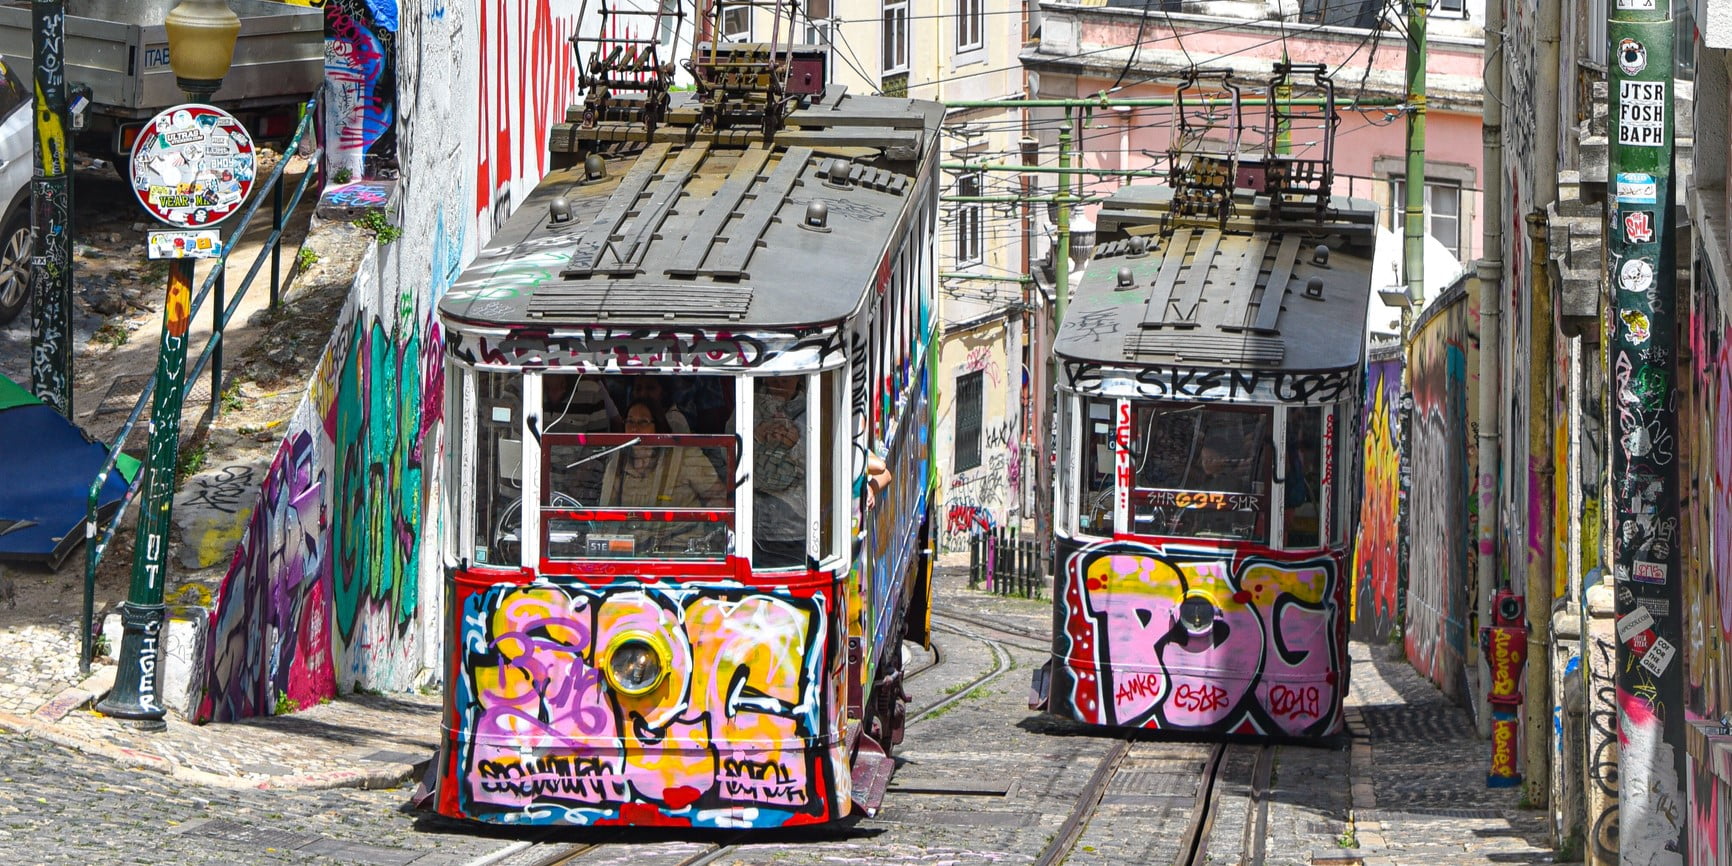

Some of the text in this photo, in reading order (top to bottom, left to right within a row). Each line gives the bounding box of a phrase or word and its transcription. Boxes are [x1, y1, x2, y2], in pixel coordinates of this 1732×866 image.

[1621, 83, 1663, 100] JTSR
[1621, 104, 1663, 122] FOSH
[1620, 125, 1662, 143] BAPH
[1625, 216, 1651, 236] SML
[1648, 652, 1660, 663] THE
[1653, 646, 1666, 658] FOR
[1643, 659, 1661, 674] GIRLS
